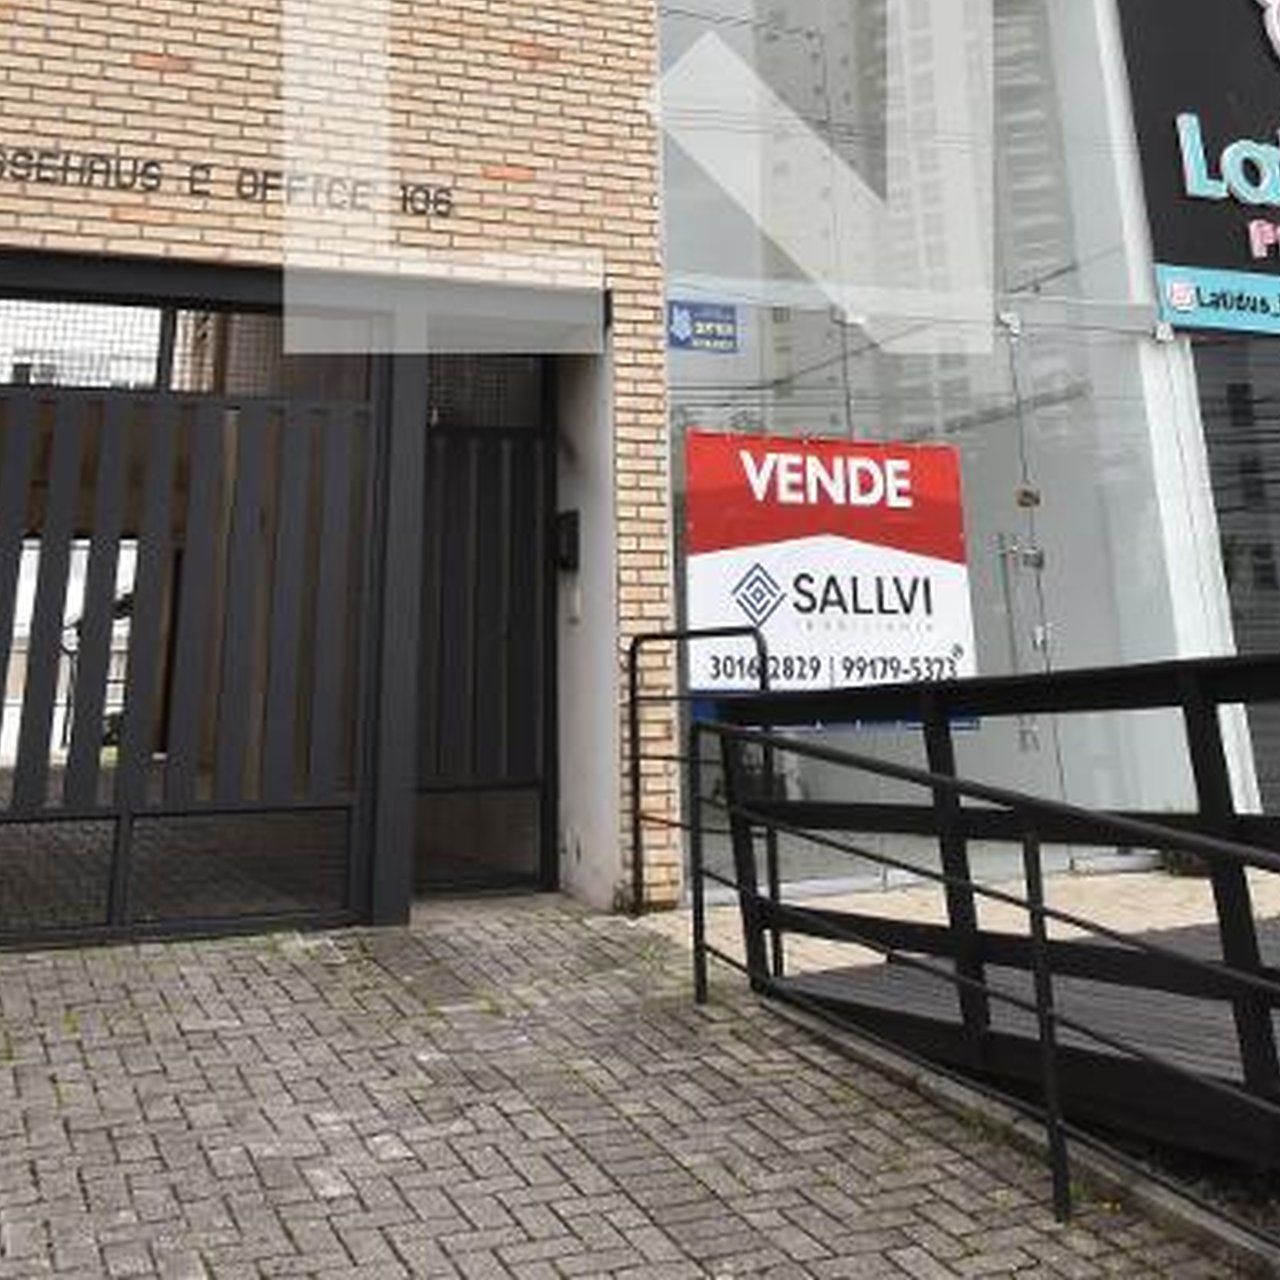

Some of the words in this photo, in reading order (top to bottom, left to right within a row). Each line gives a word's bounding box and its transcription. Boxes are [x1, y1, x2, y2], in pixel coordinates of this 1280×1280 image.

[236, 168, 373, 212] OFFICE
[399, 184, 456, 217] 106
[739, 449, 914, 508] VENDE
[792, 572, 933, 617] SALLVI
[709, 654, 822, 681] 30162829
